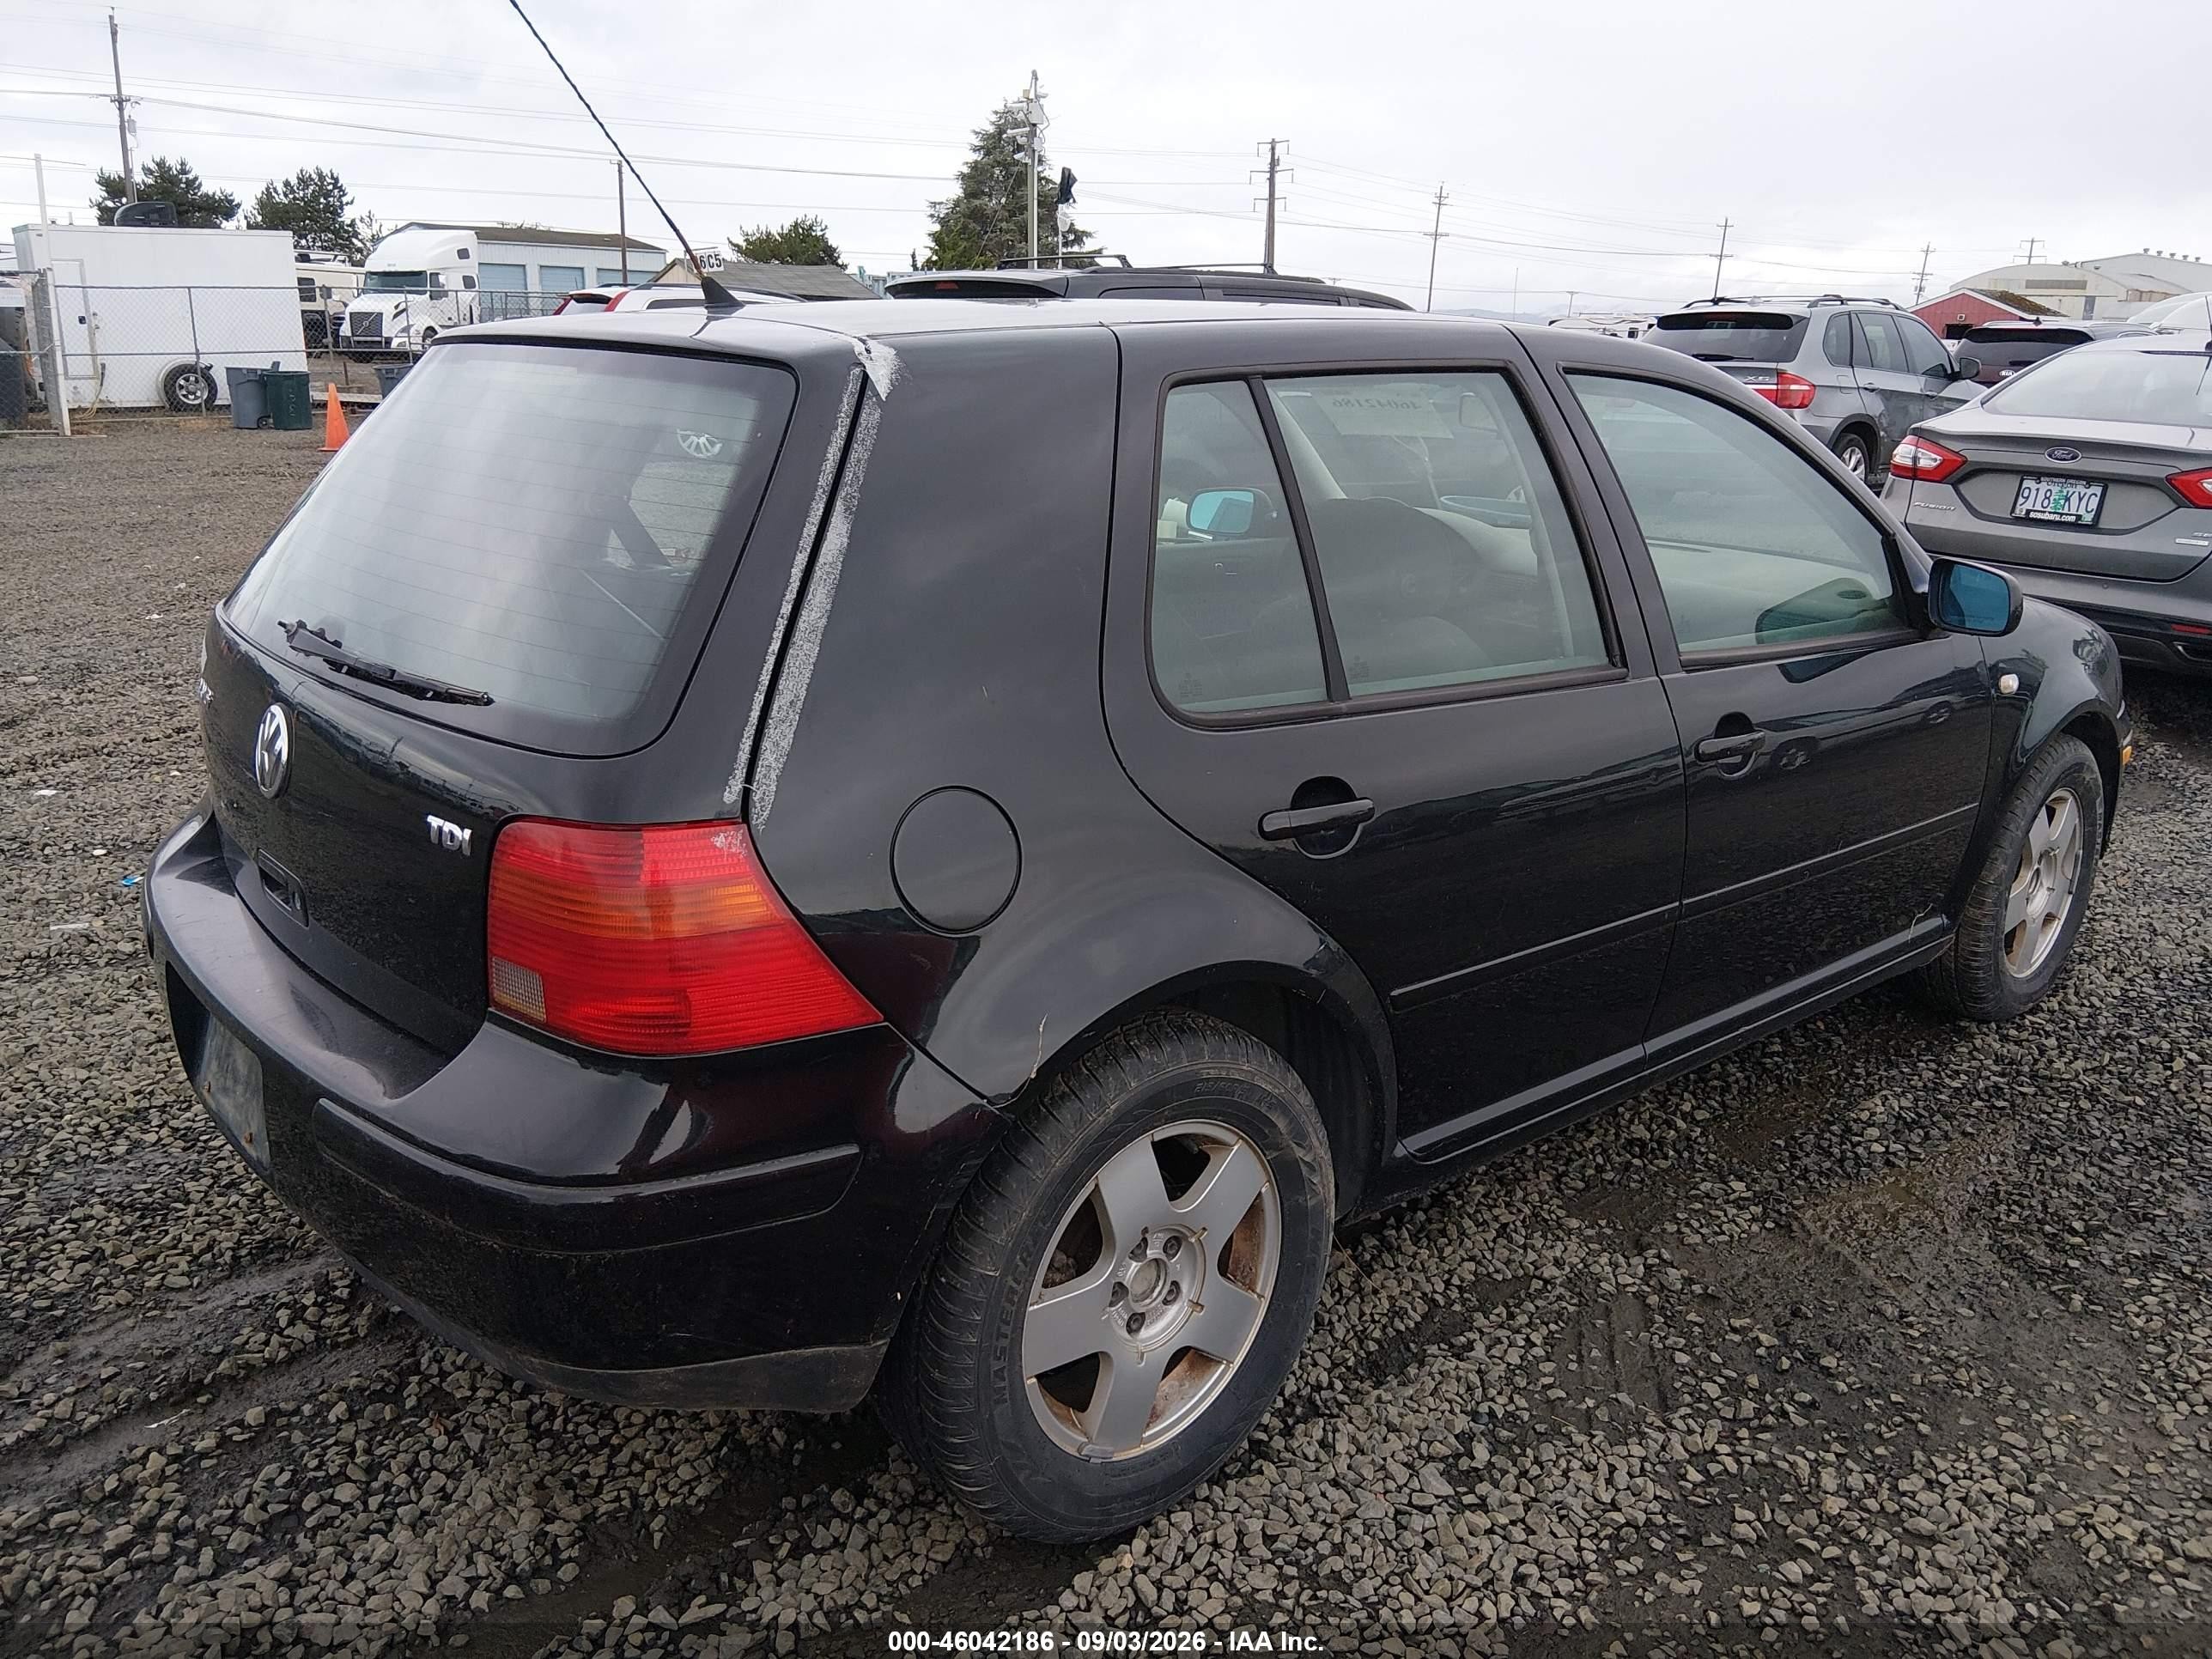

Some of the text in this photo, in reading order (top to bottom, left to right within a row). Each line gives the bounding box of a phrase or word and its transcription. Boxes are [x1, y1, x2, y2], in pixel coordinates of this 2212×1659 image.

[699, 253, 722, 270] 6C5
[1914, 501, 1956, 511] FUSION
[2019, 487, 2098, 514] 918 KYC
[2029, 511, 2076, 522] sosubaru.com
[426, 814, 472, 856] TDI
